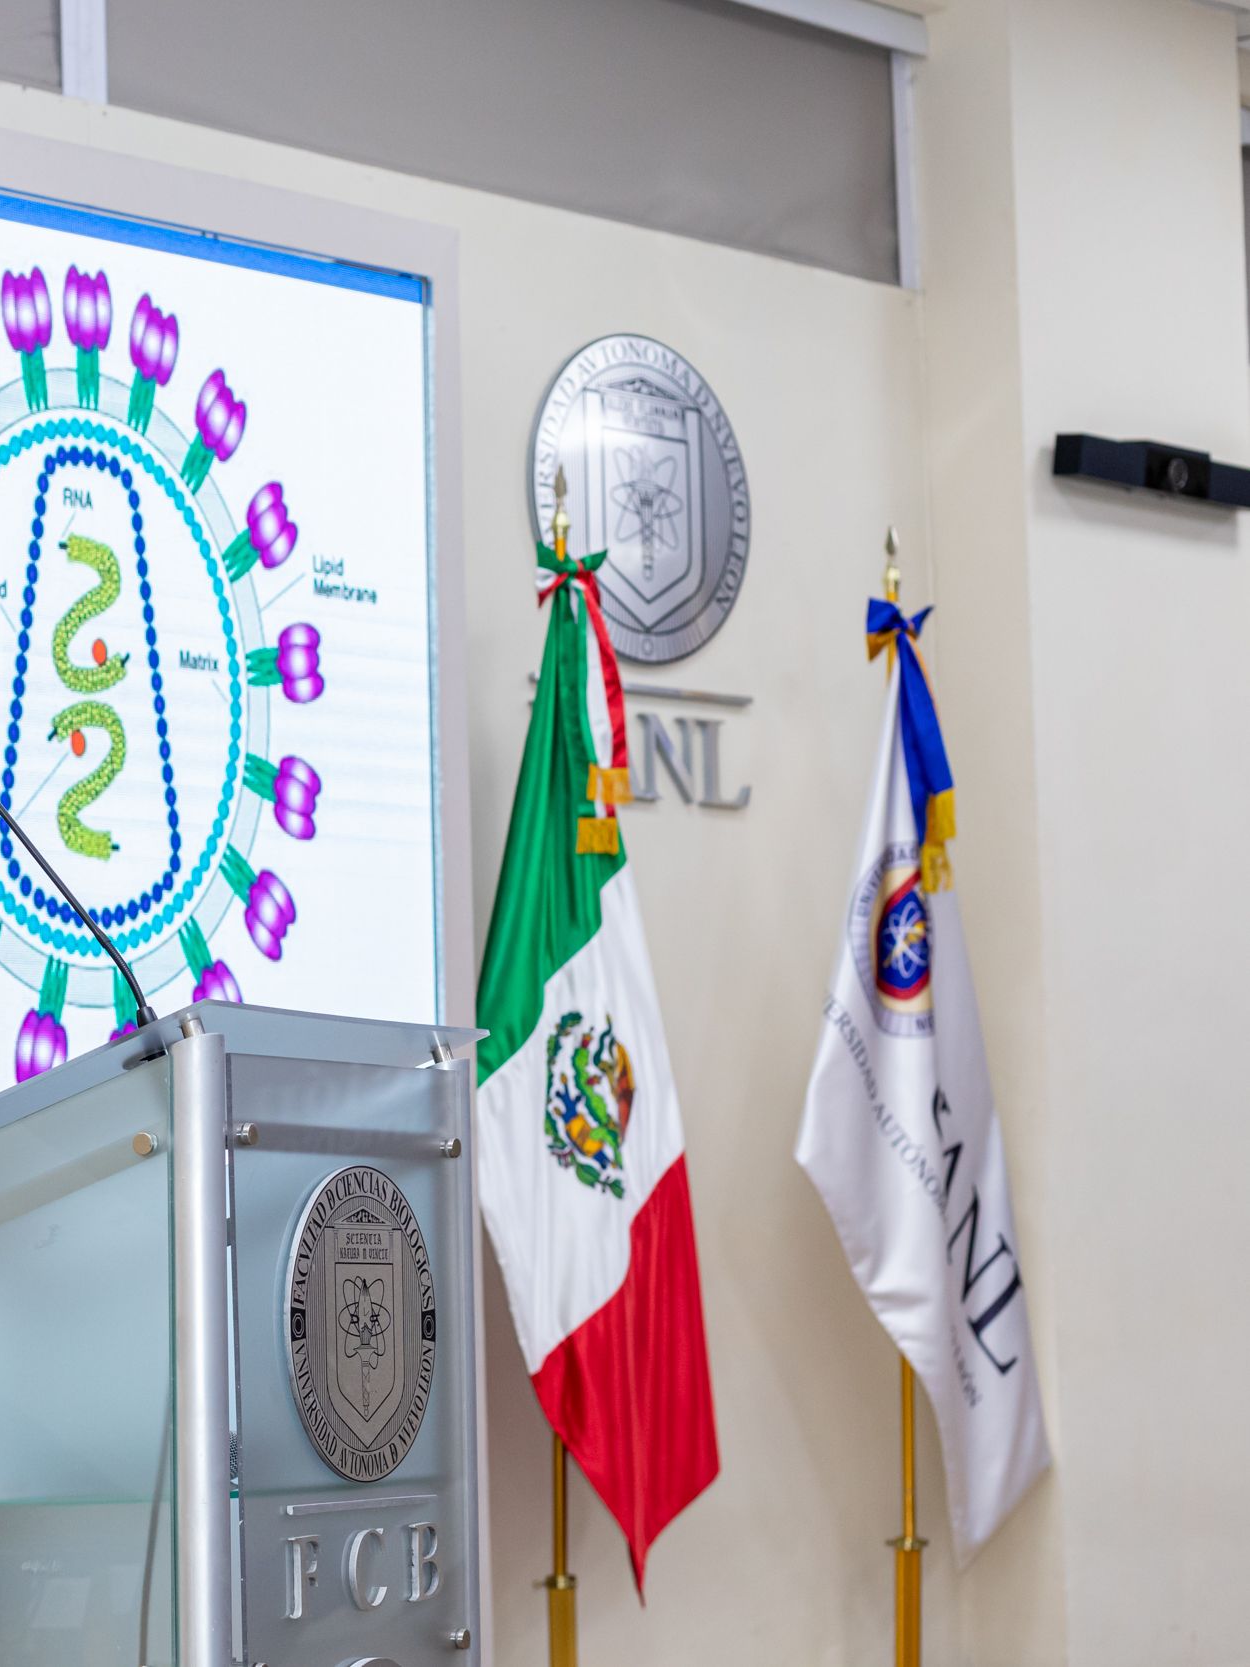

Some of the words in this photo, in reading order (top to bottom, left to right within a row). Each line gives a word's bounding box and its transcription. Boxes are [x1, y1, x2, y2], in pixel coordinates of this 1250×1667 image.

[63, 488, 94, 511] RNA
[313, 555, 344, 579] Lipid
[313, 580, 377, 605] Membrane
[179, 649, 219, 674] Matrix
[627, 711, 752, 812] NL
[335, 1171, 389, 1202] CIENCIAS
[389, 1188, 434, 1309] BIOLOGICAS
[337, 1448, 389, 1478] AVTONOMA
[418, 1345, 434, 1395] LEON
